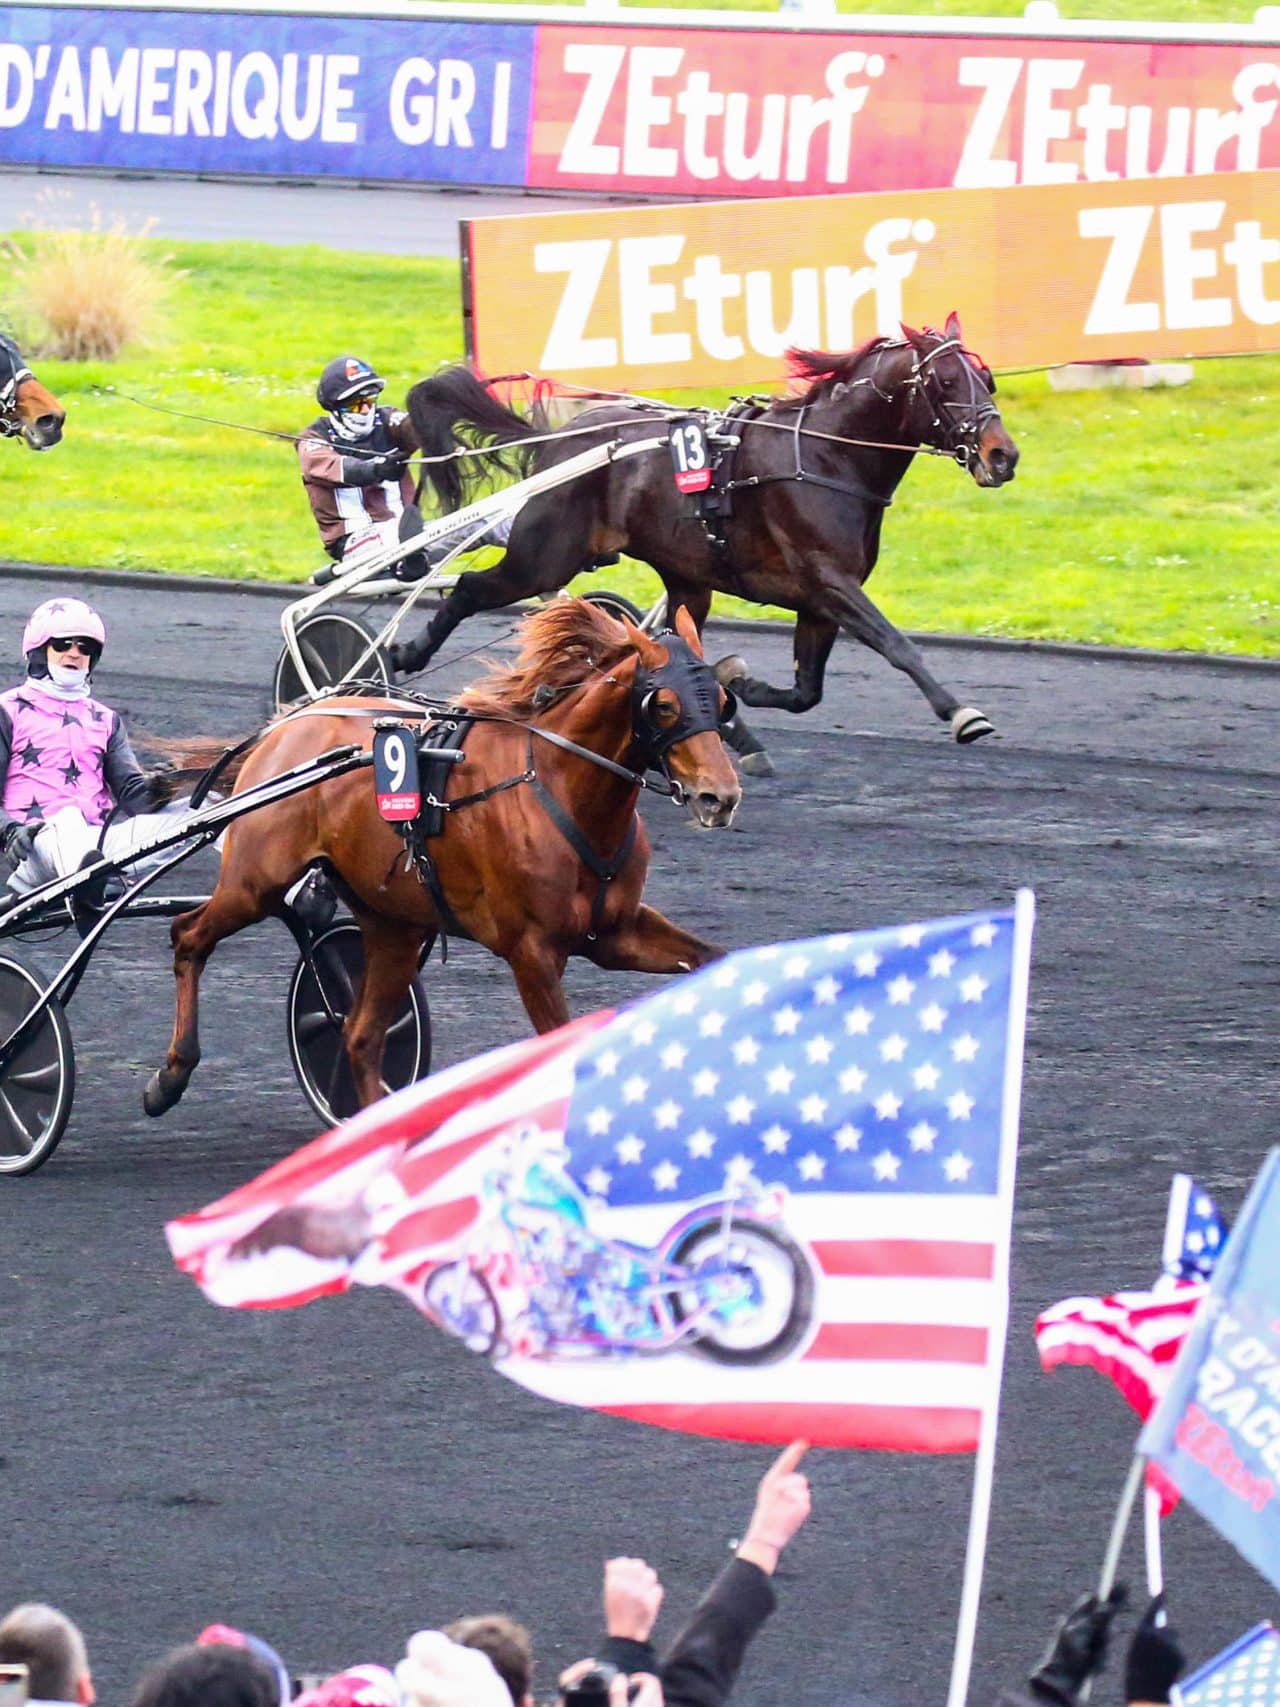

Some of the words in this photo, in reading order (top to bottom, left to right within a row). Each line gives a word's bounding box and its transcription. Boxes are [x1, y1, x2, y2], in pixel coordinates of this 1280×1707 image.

[389, 57, 475, 147] GR
[557, 44, 885, 183] ZEturf
[952, 56, 1280, 188] ZEturf
[533, 218, 937, 371] ZEturf
[1077, 200, 1280, 335] ZEt
[671, 424, 706, 472] 13
[384, 735, 407, 792] 9
